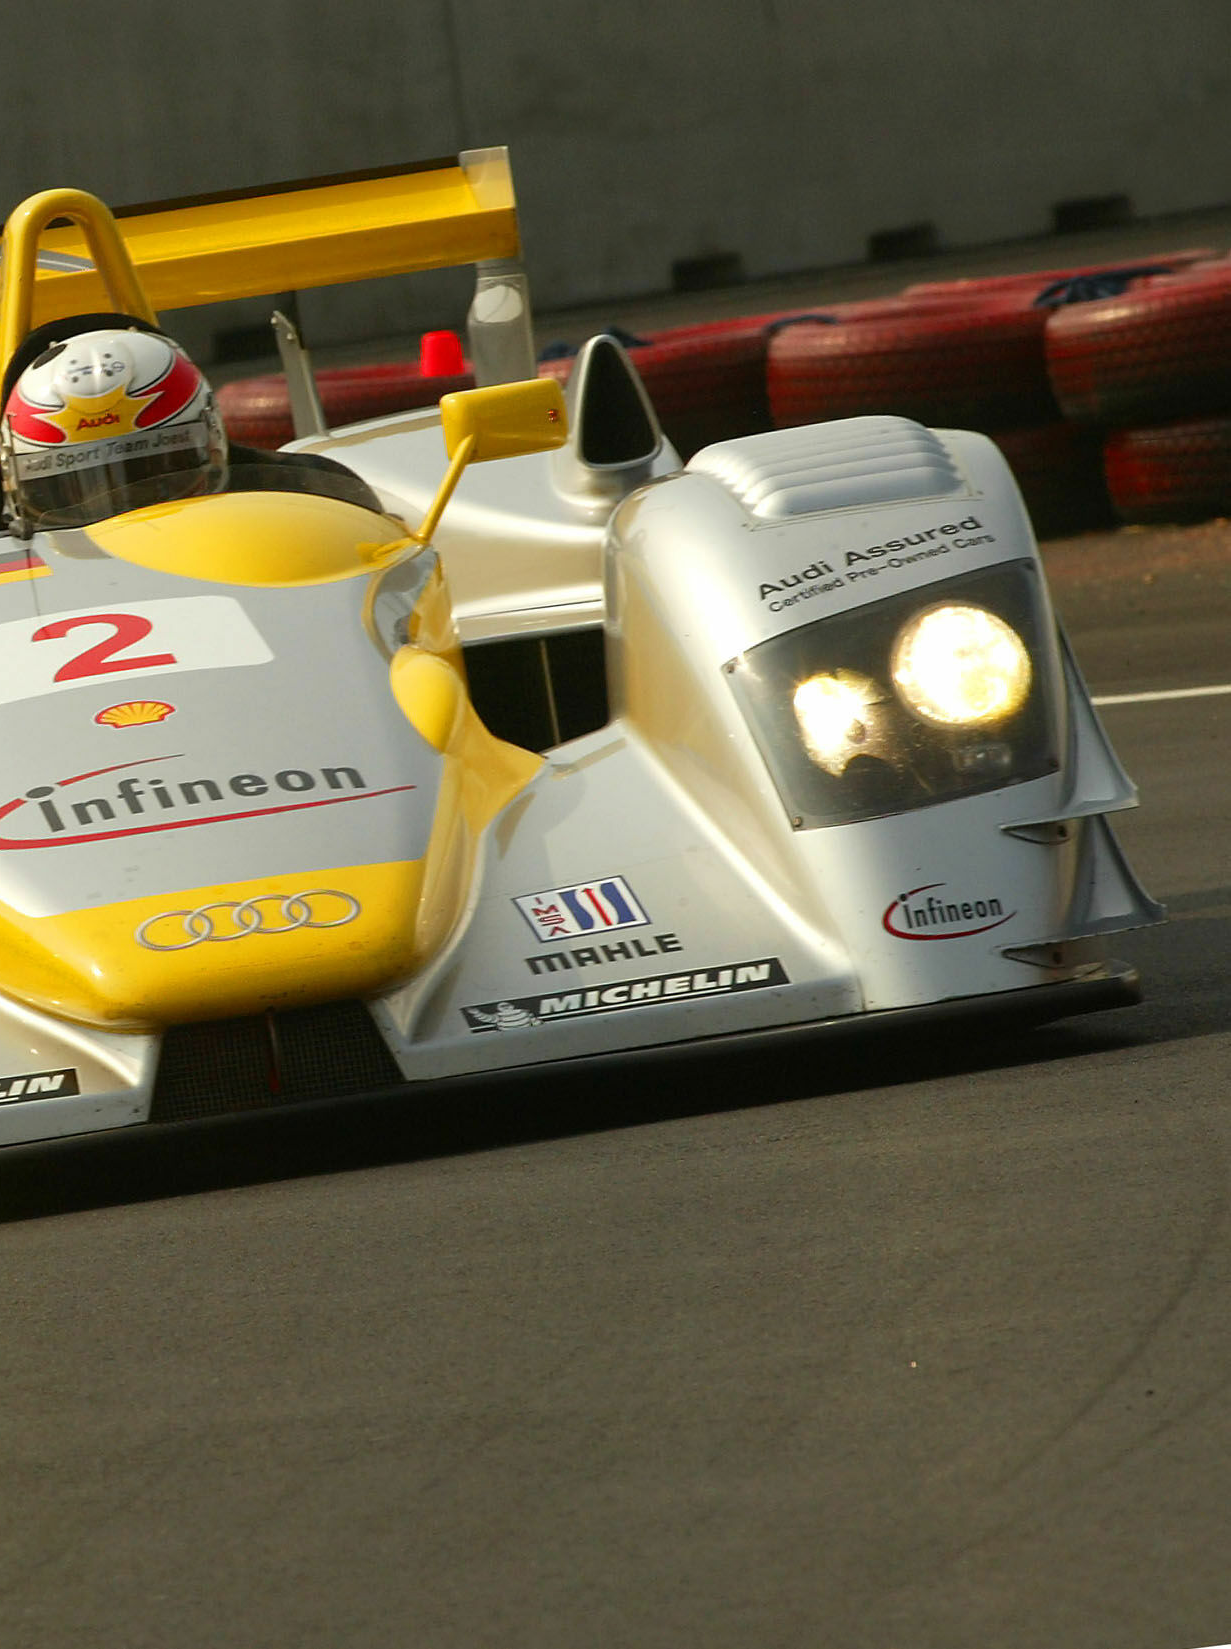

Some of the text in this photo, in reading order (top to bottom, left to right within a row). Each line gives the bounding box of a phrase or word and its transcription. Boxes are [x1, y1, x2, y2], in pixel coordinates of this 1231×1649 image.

[76, 408, 121, 432] Audi
[55, 448, 100, 468] Sport
[107, 440, 149, 454] Team
[758, 515, 984, 601] Audi Assured
[768, 532, 997, 613] Certified Pre-Owned Cars
[31, 612, 178, 684] 2
[530, 896, 571, 937] IMSA
[524, 931, 684, 976] MAHLE
[538, 962, 771, 1016] MICHELIN
